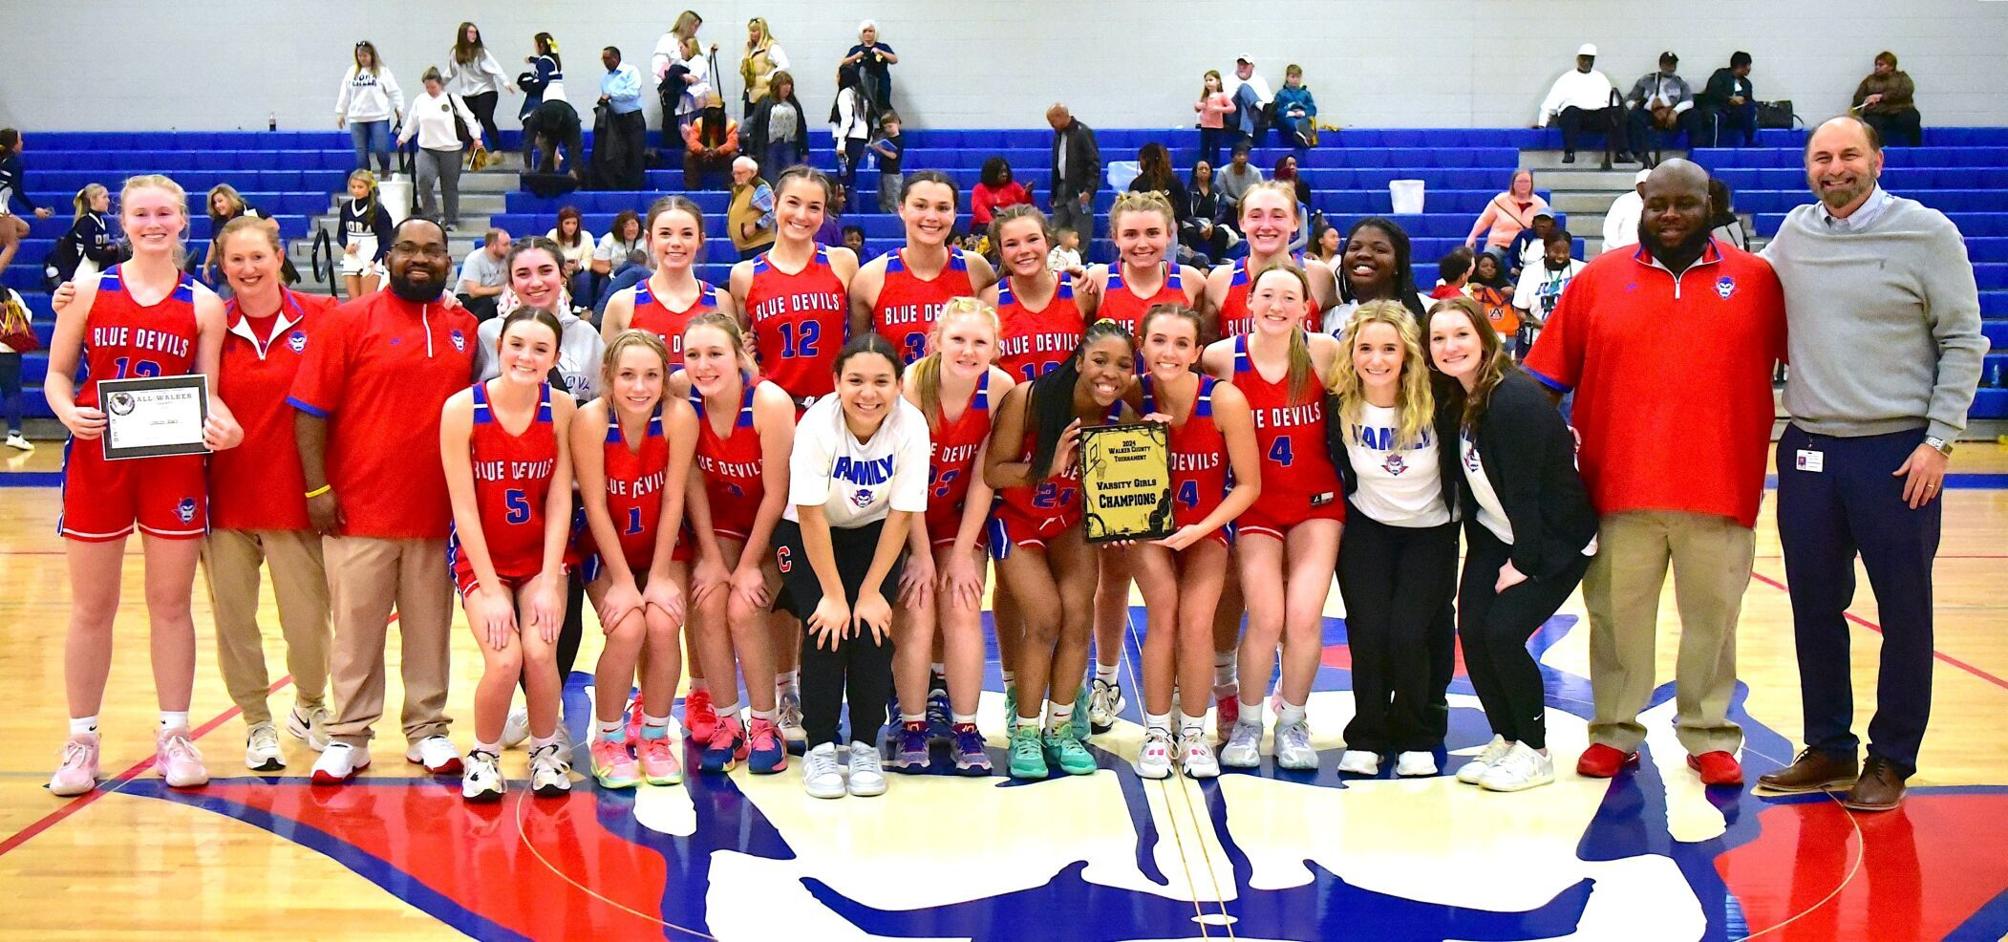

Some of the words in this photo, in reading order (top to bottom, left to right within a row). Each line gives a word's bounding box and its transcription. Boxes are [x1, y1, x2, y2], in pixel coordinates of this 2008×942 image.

[756, 296, 786, 321] BLUE
[792, 292, 840, 311] DEVILS
[885, 304, 917, 326] BLUE
[94, 326, 129, 347] BLUE
[135, 328, 189, 358] DEVILS
[777, 319, 822, 359] 12
[999, 335, 1030, 356] BLUE
[1036, 333, 1080, 352] DEVILS
[1271, 401, 1321, 428] DEVILS
[1267, 434, 1295, 468] 4
[1096, 481, 1131, 490] VARSITY
[1134, 479, 1157, 487] GIRLS
[504, 488, 532, 525] 5
[1099, 493, 1157, 508] CHAMPIONS
[623, 505, 645, 536] 1
[776, 545, 792, 573] C
